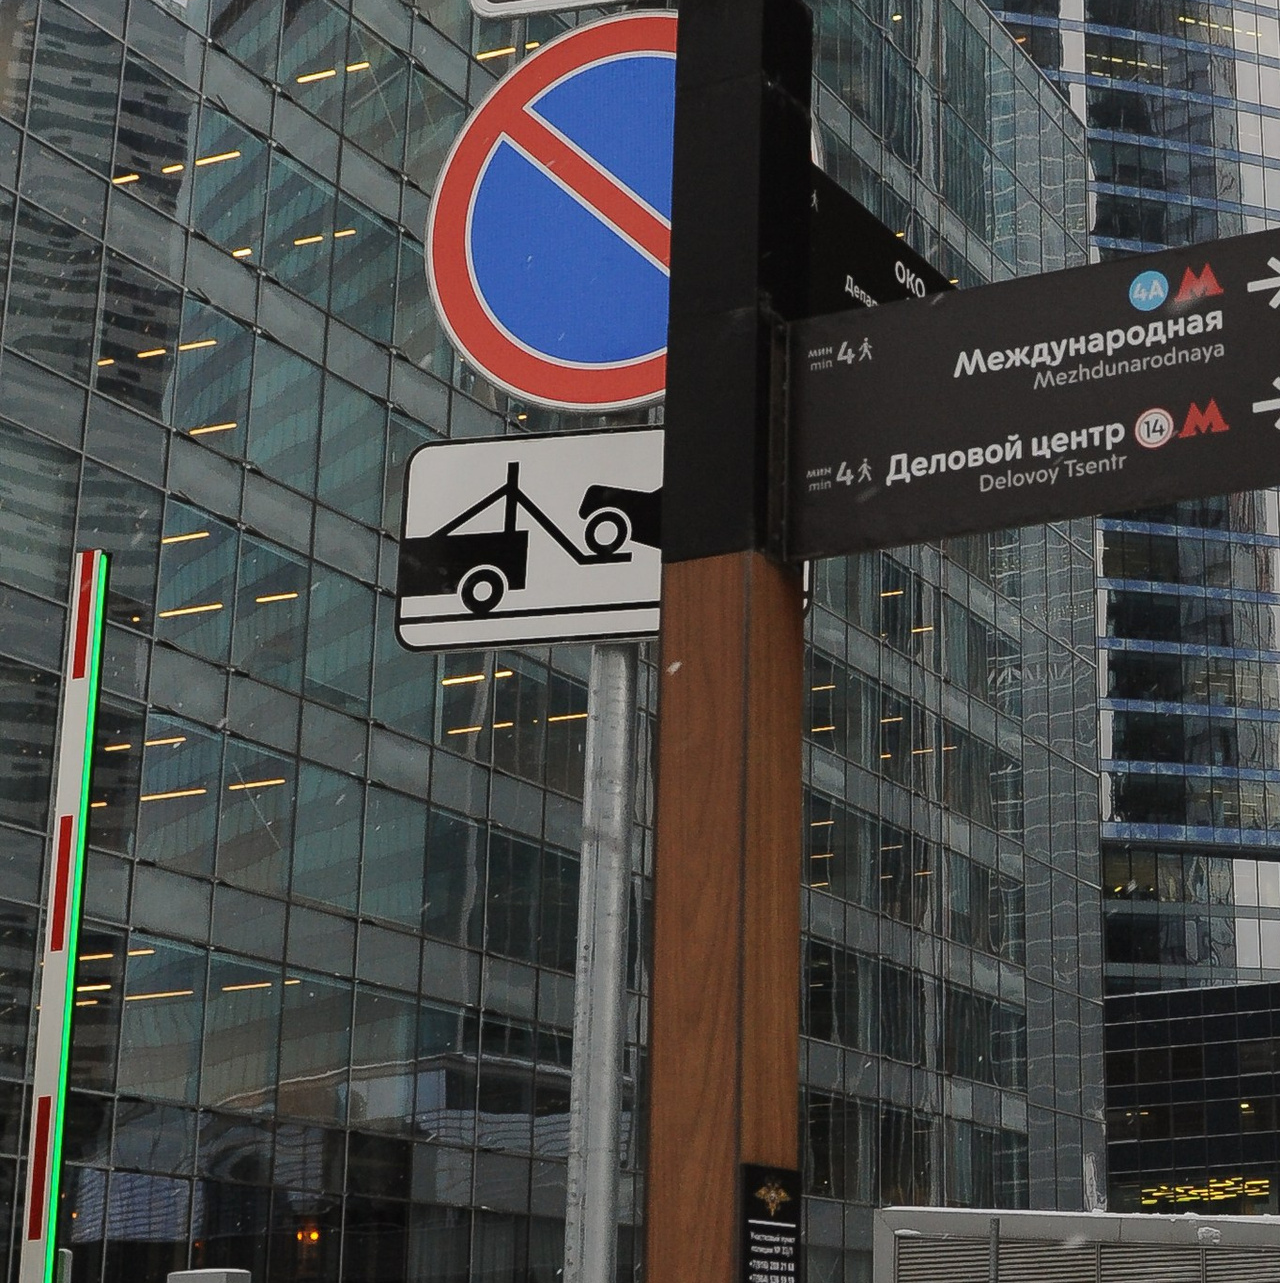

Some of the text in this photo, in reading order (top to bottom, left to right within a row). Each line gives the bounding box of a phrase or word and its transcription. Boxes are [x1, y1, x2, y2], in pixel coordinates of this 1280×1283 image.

[895, 260, 926, 298] ОКО
[808, 339, 856, 365] мин 4
[953, 310, 1223, 378] Международная
[810, 357, 833, 372] min
[1033, 343, 1225, 390] Mezhdunarodnaya
[885, 434, 1023, 485] Деловой
[1031, 420, 1125, 458] центр
[1143, 418, 1165, 439] 14
[806, 461, 855, 486] мин 4
[808, 478, 832, 492] min
[979, 453, 1128, 493] Delovoy Tsentr
